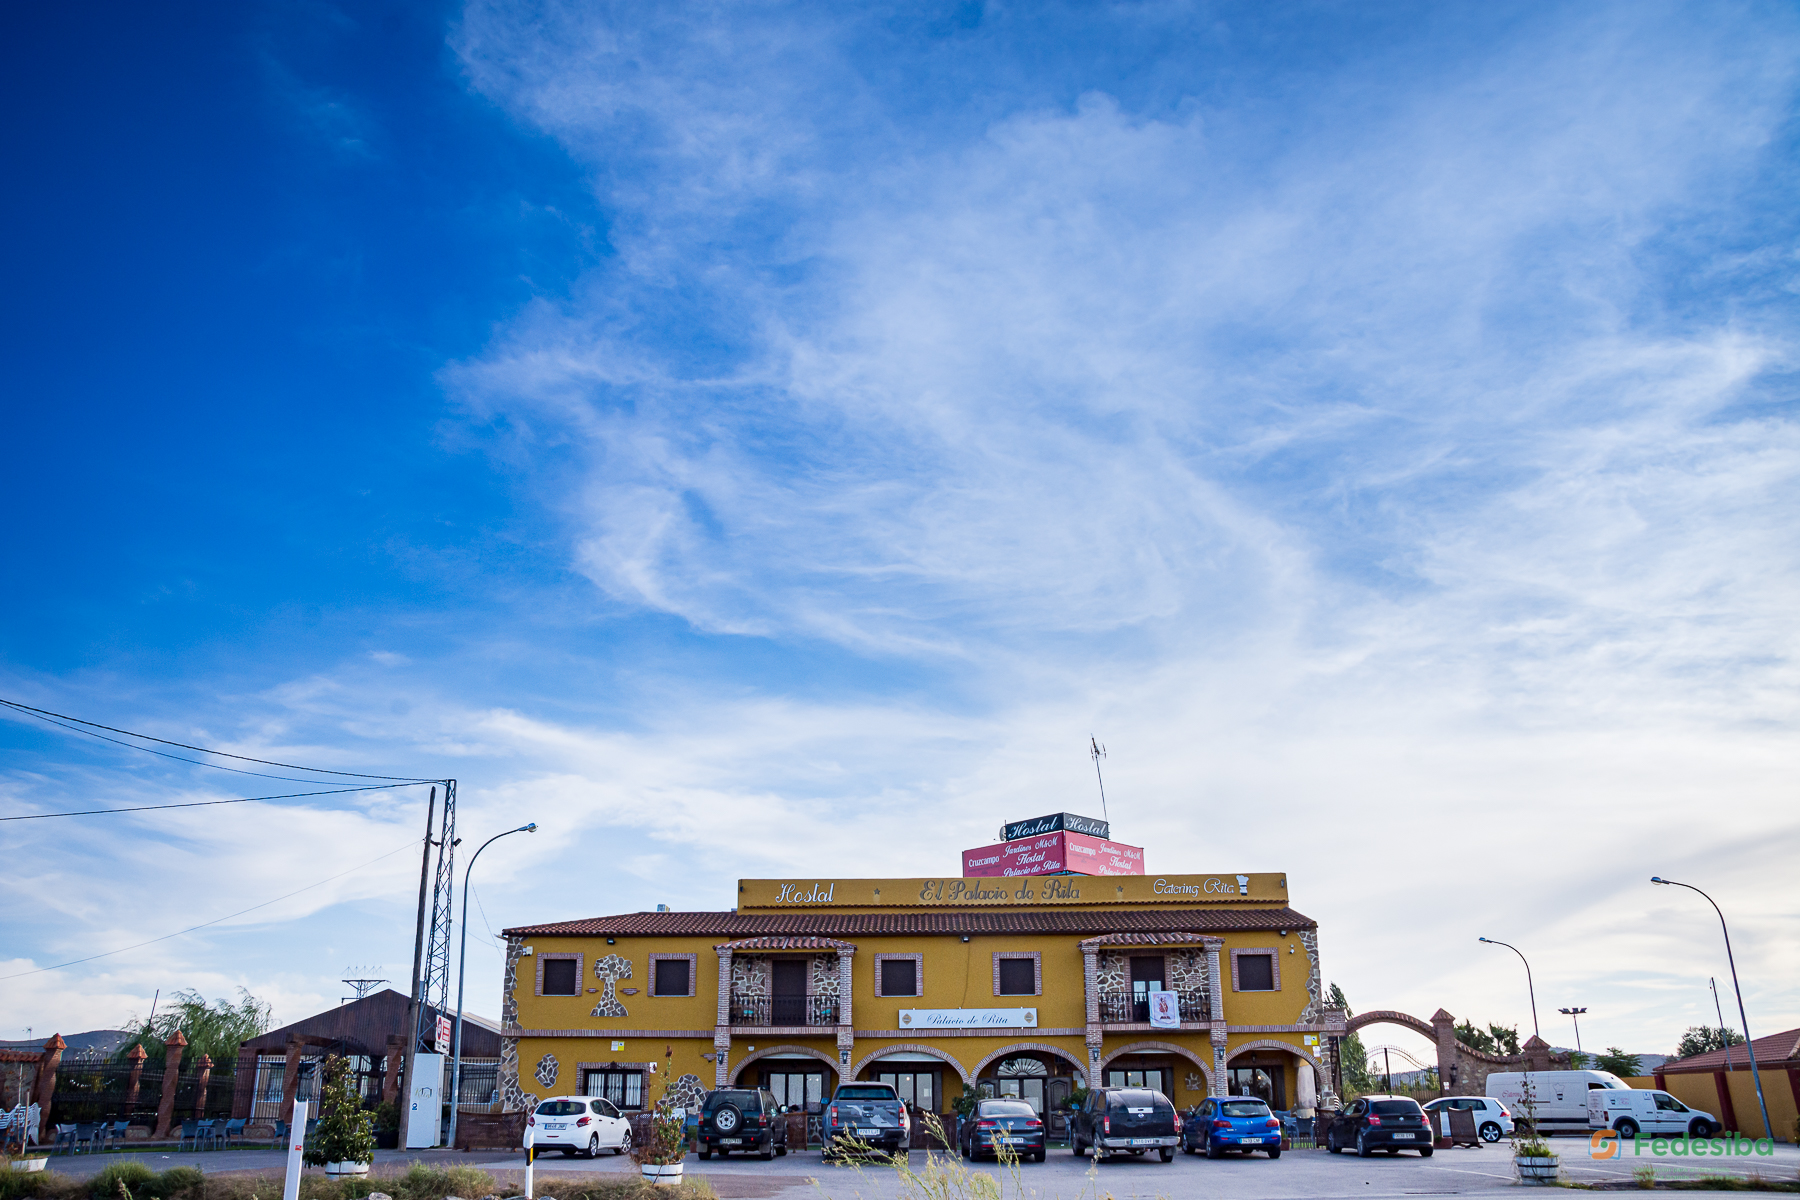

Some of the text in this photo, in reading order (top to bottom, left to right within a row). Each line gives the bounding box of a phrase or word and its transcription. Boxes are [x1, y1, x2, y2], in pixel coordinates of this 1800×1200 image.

[1009, 817, 1058, 839] Hostal
[1066, 817, 1106, 836] Hostal
[1069, 842, 1096, 856] Cruzcampo
[968, 856, 1000, 867] Cruzcampo
[1016, 851, 1046, 865] Hostal
[1109, 856, 1132, 870] Hostal
[1002, 864, 1030, 877] Palacio
[1030, 864, 1041, 873] de
[1042, 860, 1061, 871] Rita
[776, 882, 834, 903] Hostal
[920, 878, 1080, 900] El Palacio de Rita
[1154, 878, 1234, 898] Catering Rita
[967, 1015, 978, 1024] de
[982, 1012, 1008, 1024] Rita
[412, 1102, 418, 1110] 2
